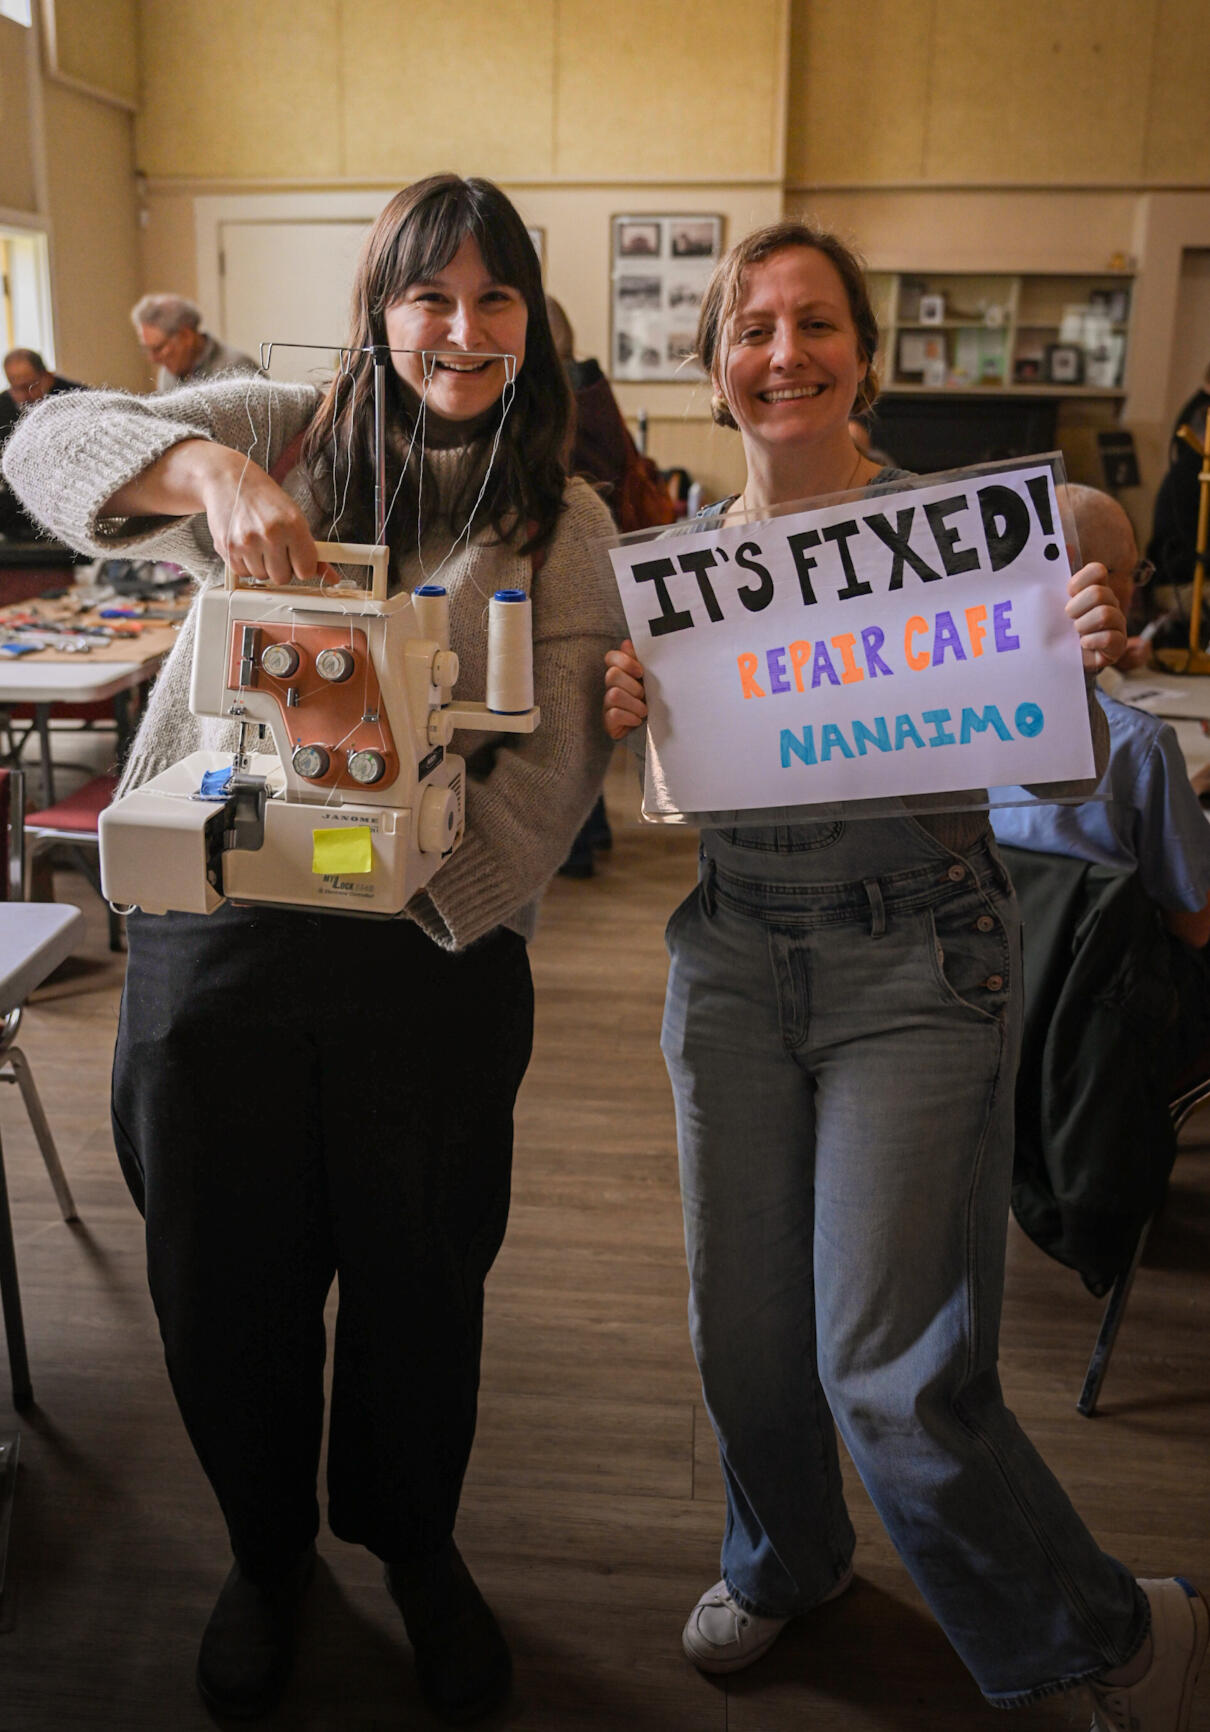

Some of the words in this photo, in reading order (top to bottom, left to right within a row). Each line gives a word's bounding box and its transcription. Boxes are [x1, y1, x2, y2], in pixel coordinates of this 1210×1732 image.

[631, 541, 774, 637] IT'S
[787, 475, 1060, 606] FIXED!
[737, 625, 894, 700] REPAIR
[904, 600, 1021, 672] CAFE
[779, 702, 1045, 769] NANAIMO
[321, 813, 378, 824] JANOME
